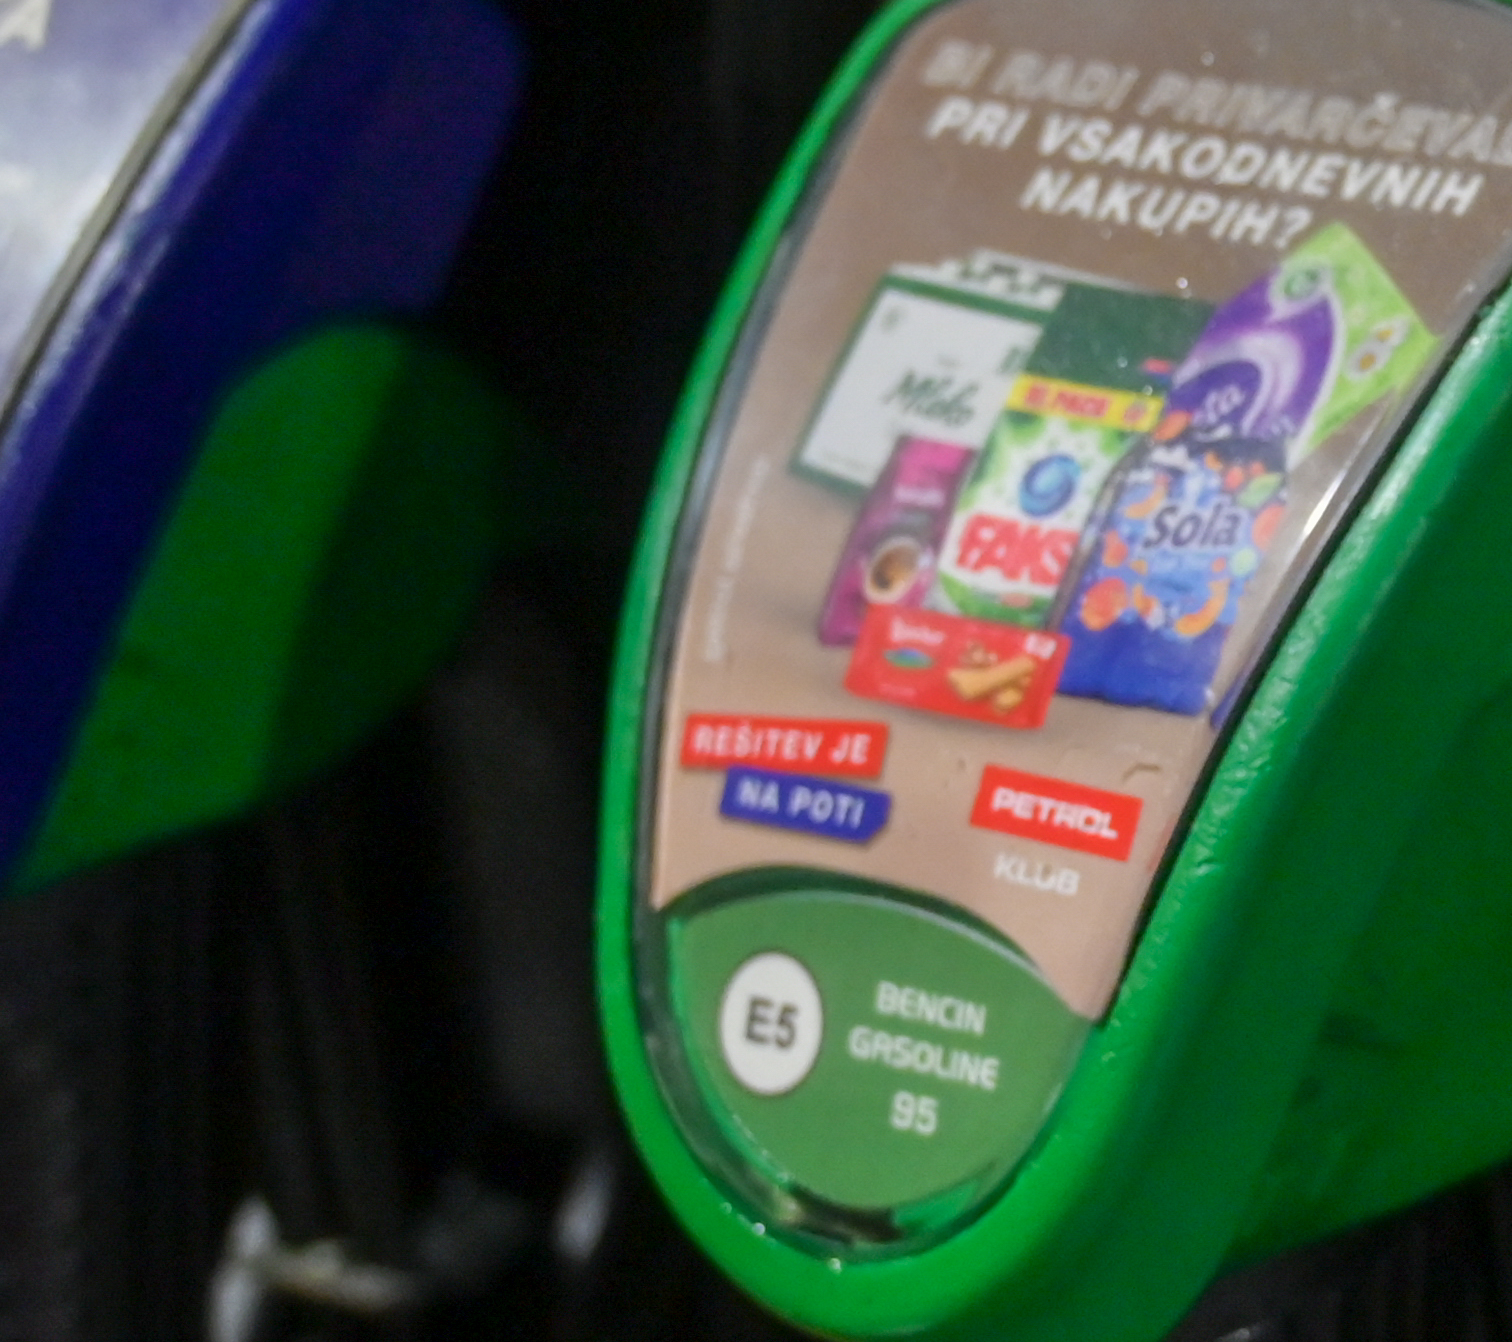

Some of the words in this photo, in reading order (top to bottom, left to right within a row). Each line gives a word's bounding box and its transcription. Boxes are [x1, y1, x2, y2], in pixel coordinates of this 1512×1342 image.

[991, 53, 1137, 112] RADI
[925, 97, 1027, 149] PRI
[1037, 113, 1484, 217] VSAKODNEVNIH
[1020, 168, 1313, 247] NAKUPIH?
[692, 721, 824, 763] REŠITEV
[829, 732, 872, 766] JE
[735, 778, 780, 814] NA
[788, 789, 864, 829] POTI
[990, 786, 1119, 840] PETROL
[992, 852, 1082, 896] KLUB
[743, 995, 799, 1050] E5
[875, 979, 988, 1037] BENCIN
[847, 1024, 1001, 1091] GASOLINE
[890, 1090, 939, 1136] 95
